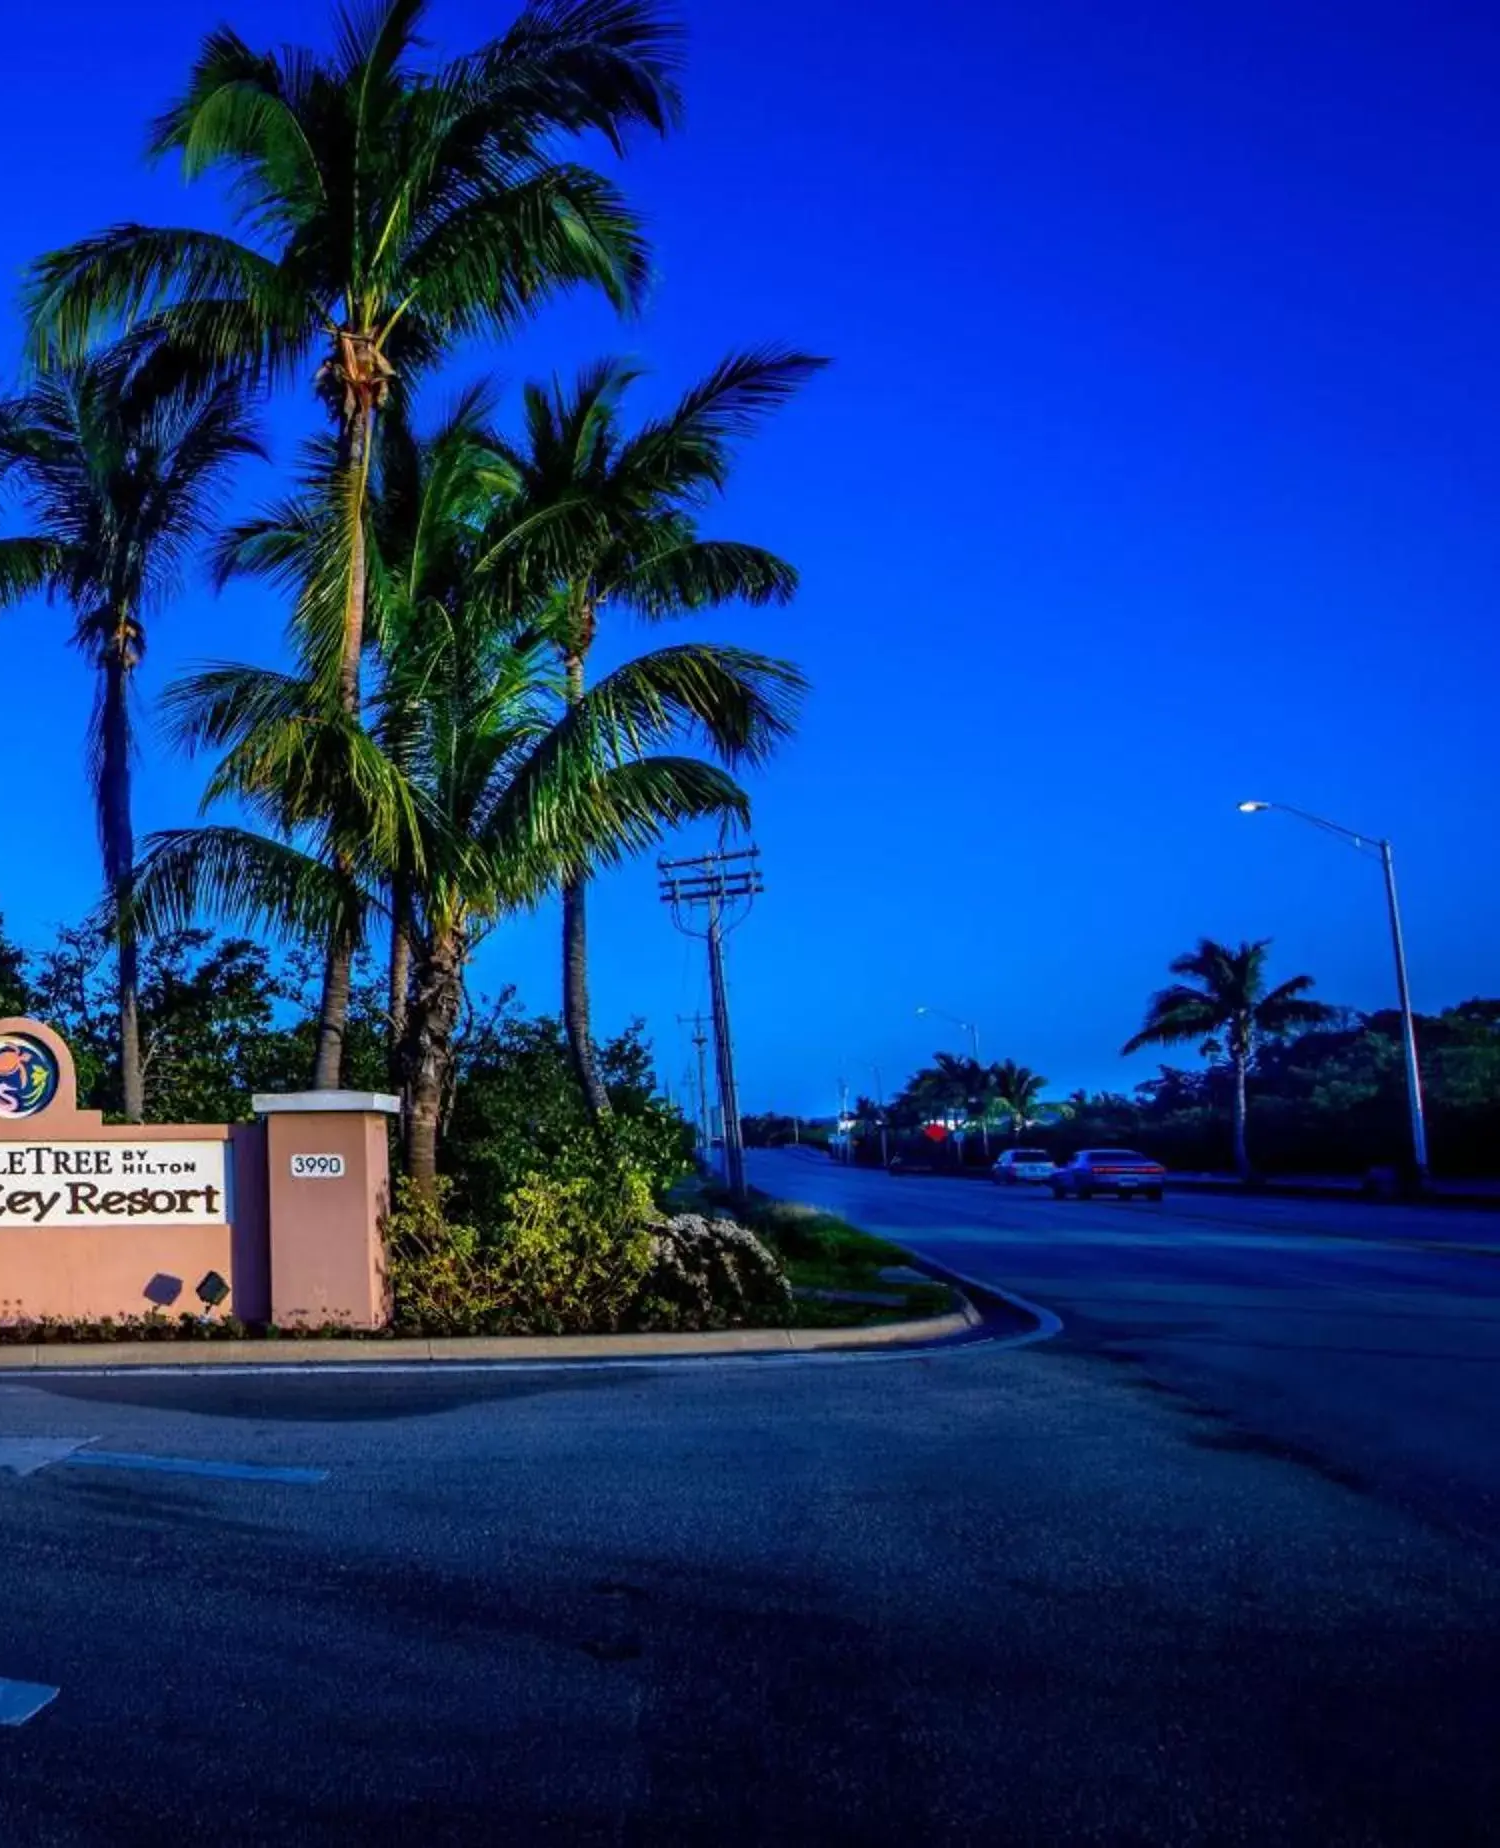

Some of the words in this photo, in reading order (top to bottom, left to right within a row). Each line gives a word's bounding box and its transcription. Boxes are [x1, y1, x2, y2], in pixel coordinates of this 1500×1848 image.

[122, 1150, 148, 1161] BY
[122, 1162, 196, 1175] HILTON
[294, 1157, 341, 1174] 3990
[65, 1182, 220, 1216] Resort
